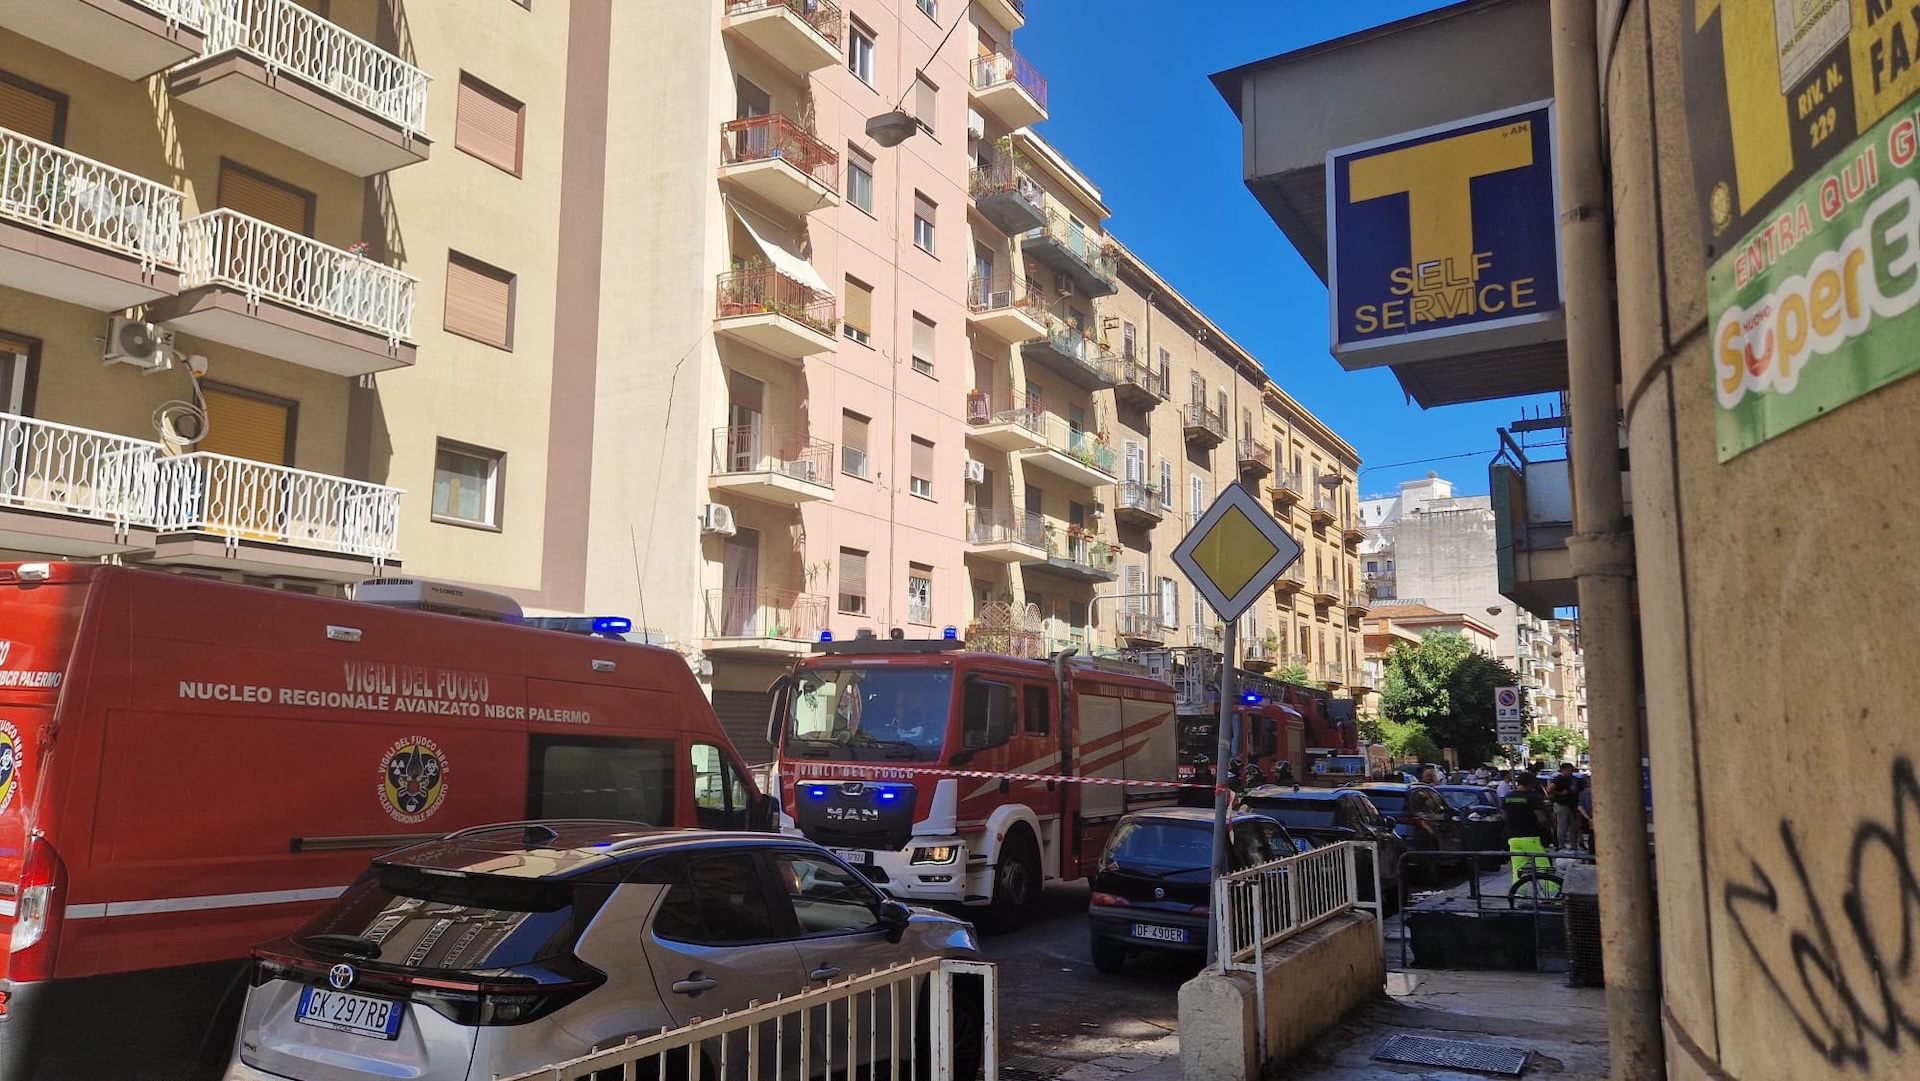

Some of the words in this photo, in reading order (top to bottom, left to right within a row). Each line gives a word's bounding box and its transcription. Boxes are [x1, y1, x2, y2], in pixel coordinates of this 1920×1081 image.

[1798, 78, 1824, 119] RIV.
[1826, 62, 1843, 93] N.
[1810, 106, 1836, 148] 229
[1349, 120, 1533, 319] T
[1734, 202, 1813, 290] ENTRA
[1820, 143, 1878, 221] QUI
[1889, 108, 1920, 168] G
[1390, 252, 1493, 296] SELF
[1355, 278, 1537, 334] SERVICE
[1720, 196, 1920, 394] SuperE
[1743, 304, 1771, 333] NUOVO
[439, 588, 464, 597] DOMETIC
[18, 670, 62, 687] PALERMO
[343, 660, 396, 695] VIGILI
[401, 666, 433, 698] DEL
[438, 671, 489, 702] FUOCO
[179, 681, 272, 703] NUCLEO
[279, 688, 389, 711] REGIONALE
[394, 697, 480, 716] AVANZATO
[485, 704, 525, 720] NBCR
[529, 708, 590, 724] PALERMO
[13, 735, 23, 769] NBCR
[378, 746, 396, 773] VIGILI
[394, 737, 410, 750] DEL
[411, 735, 437, 751] FUOCO
[435, 748, 450, 774] NBCR
[800, 765, 835, 776] VIGILI
[842, 768, 865, 778] DEL
[874, 769, 914, 779] FUOCO
[377, 783, 393, 814] NUCLEO
[390, 810, 427, 824] REGIONALE
[426, 783, 449, 818] AVANZATO
[826, 807, 878, 821] MAN
[1137, 925, 1149, 936] DF
[1152, 927, 1183, 942] 490ER
[309, 991, 333, 1018] GK
[333, 995, 389, 1029] 297RB
